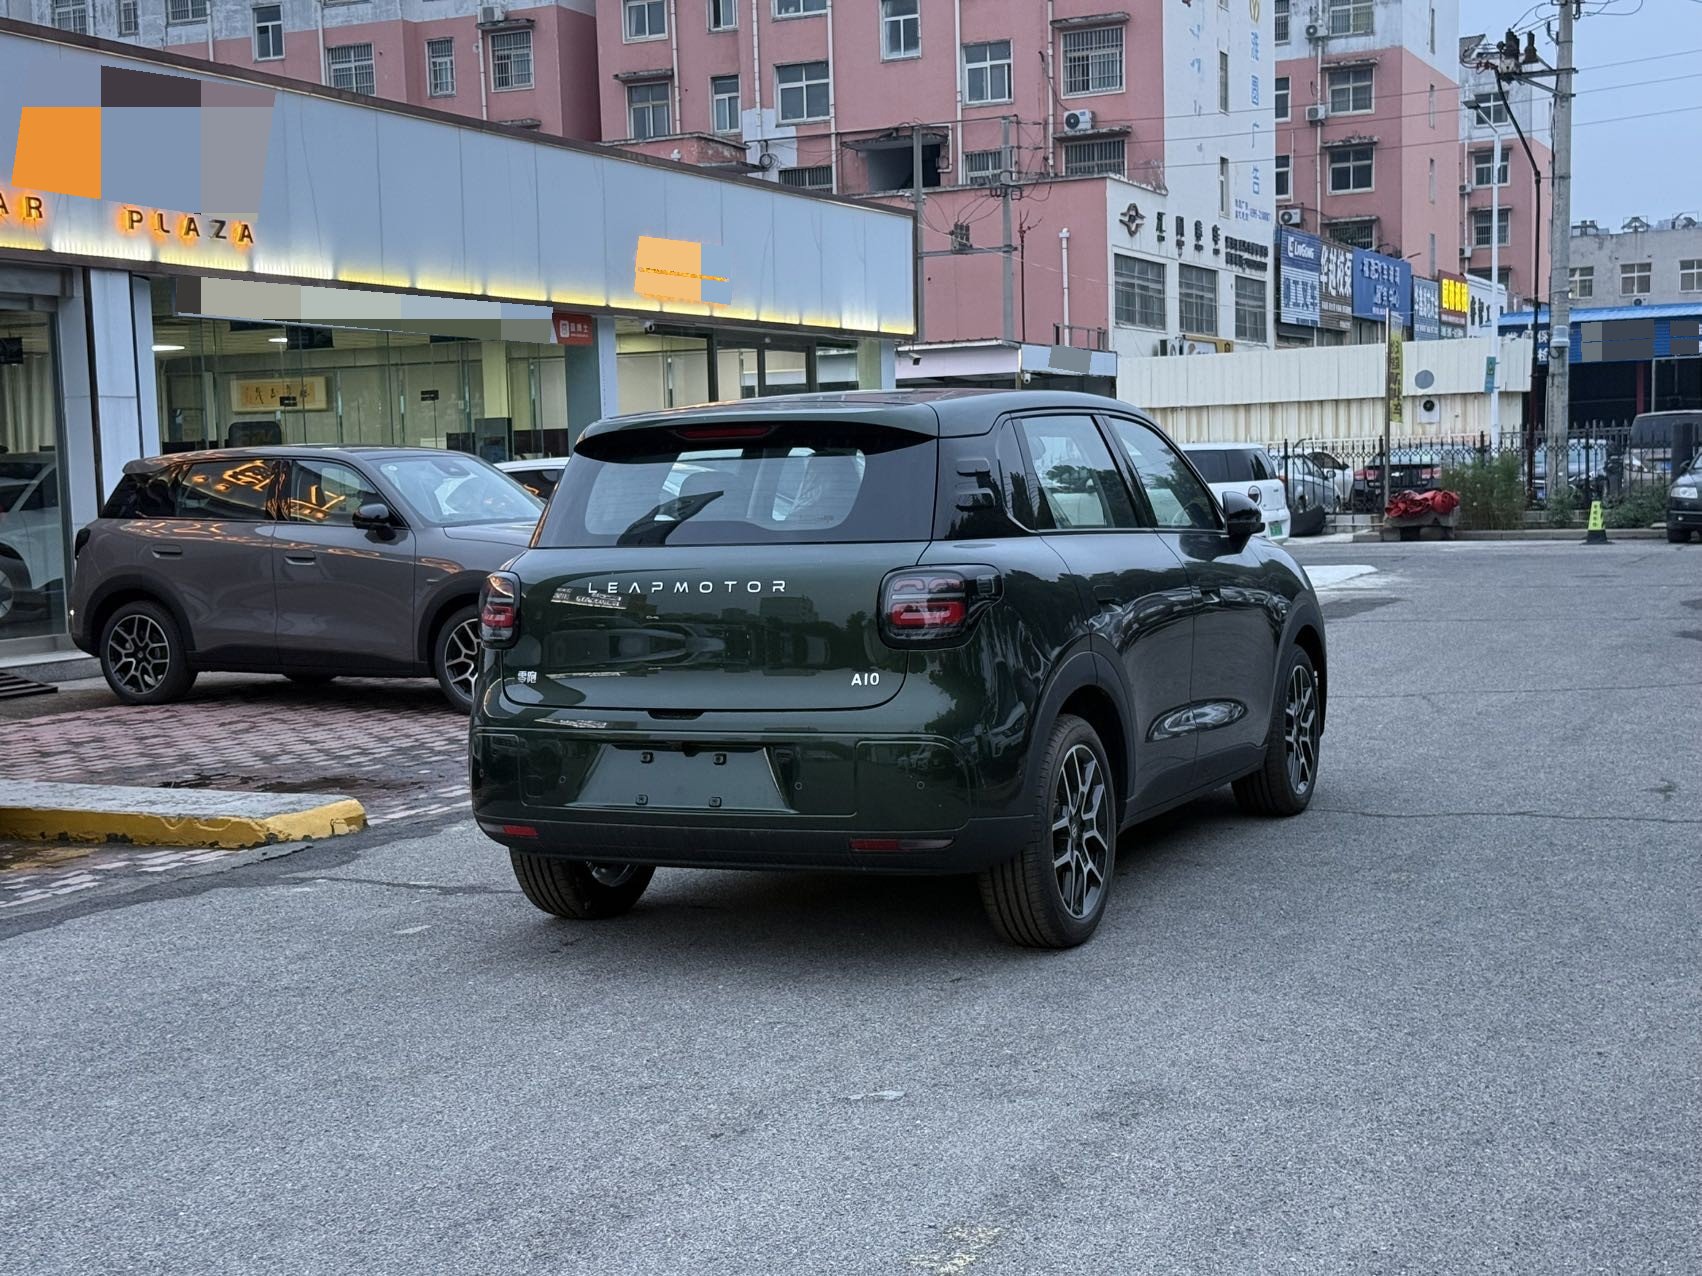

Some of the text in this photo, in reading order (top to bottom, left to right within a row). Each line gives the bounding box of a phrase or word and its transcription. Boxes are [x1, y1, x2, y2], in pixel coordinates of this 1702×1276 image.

[126, 208, 254, 243] PLAZA
[588, 580, 786, 594] LEAPMOTOR
[517, 671, 537, 684] 零跑
[851, 673, 880, 686] A10
